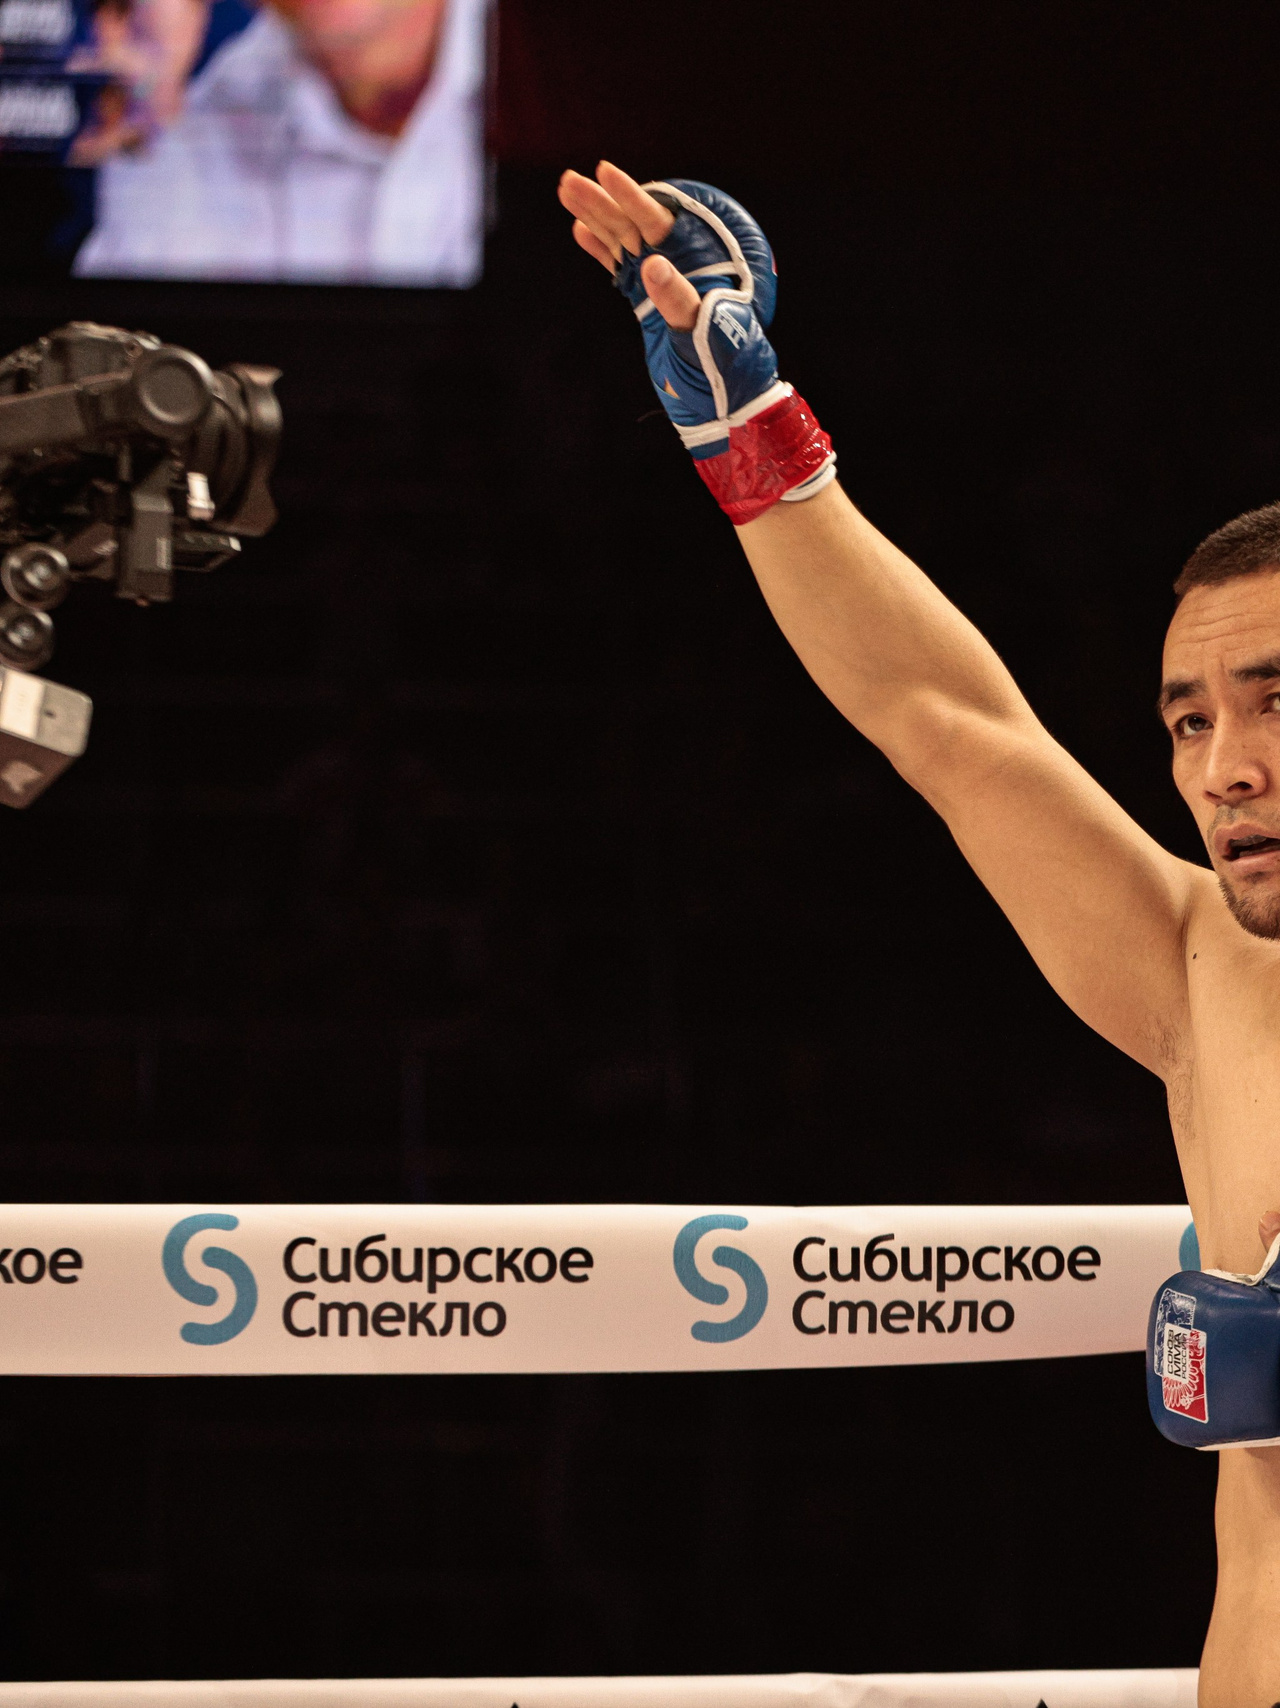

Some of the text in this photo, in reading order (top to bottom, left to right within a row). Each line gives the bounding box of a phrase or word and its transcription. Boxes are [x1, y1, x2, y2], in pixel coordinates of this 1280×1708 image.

[282, 1233, 594, 1294] Сибирское
[792, 1233, 1100, 1292] Сибирское
[282, 1291, 507, 1338] Стекло
[792, 1290, 1015, 1336] Стекло
[1167, 1329, 1175, 1375] СОЮЗ
[1173, 1332, 1182, 1378] ММА
